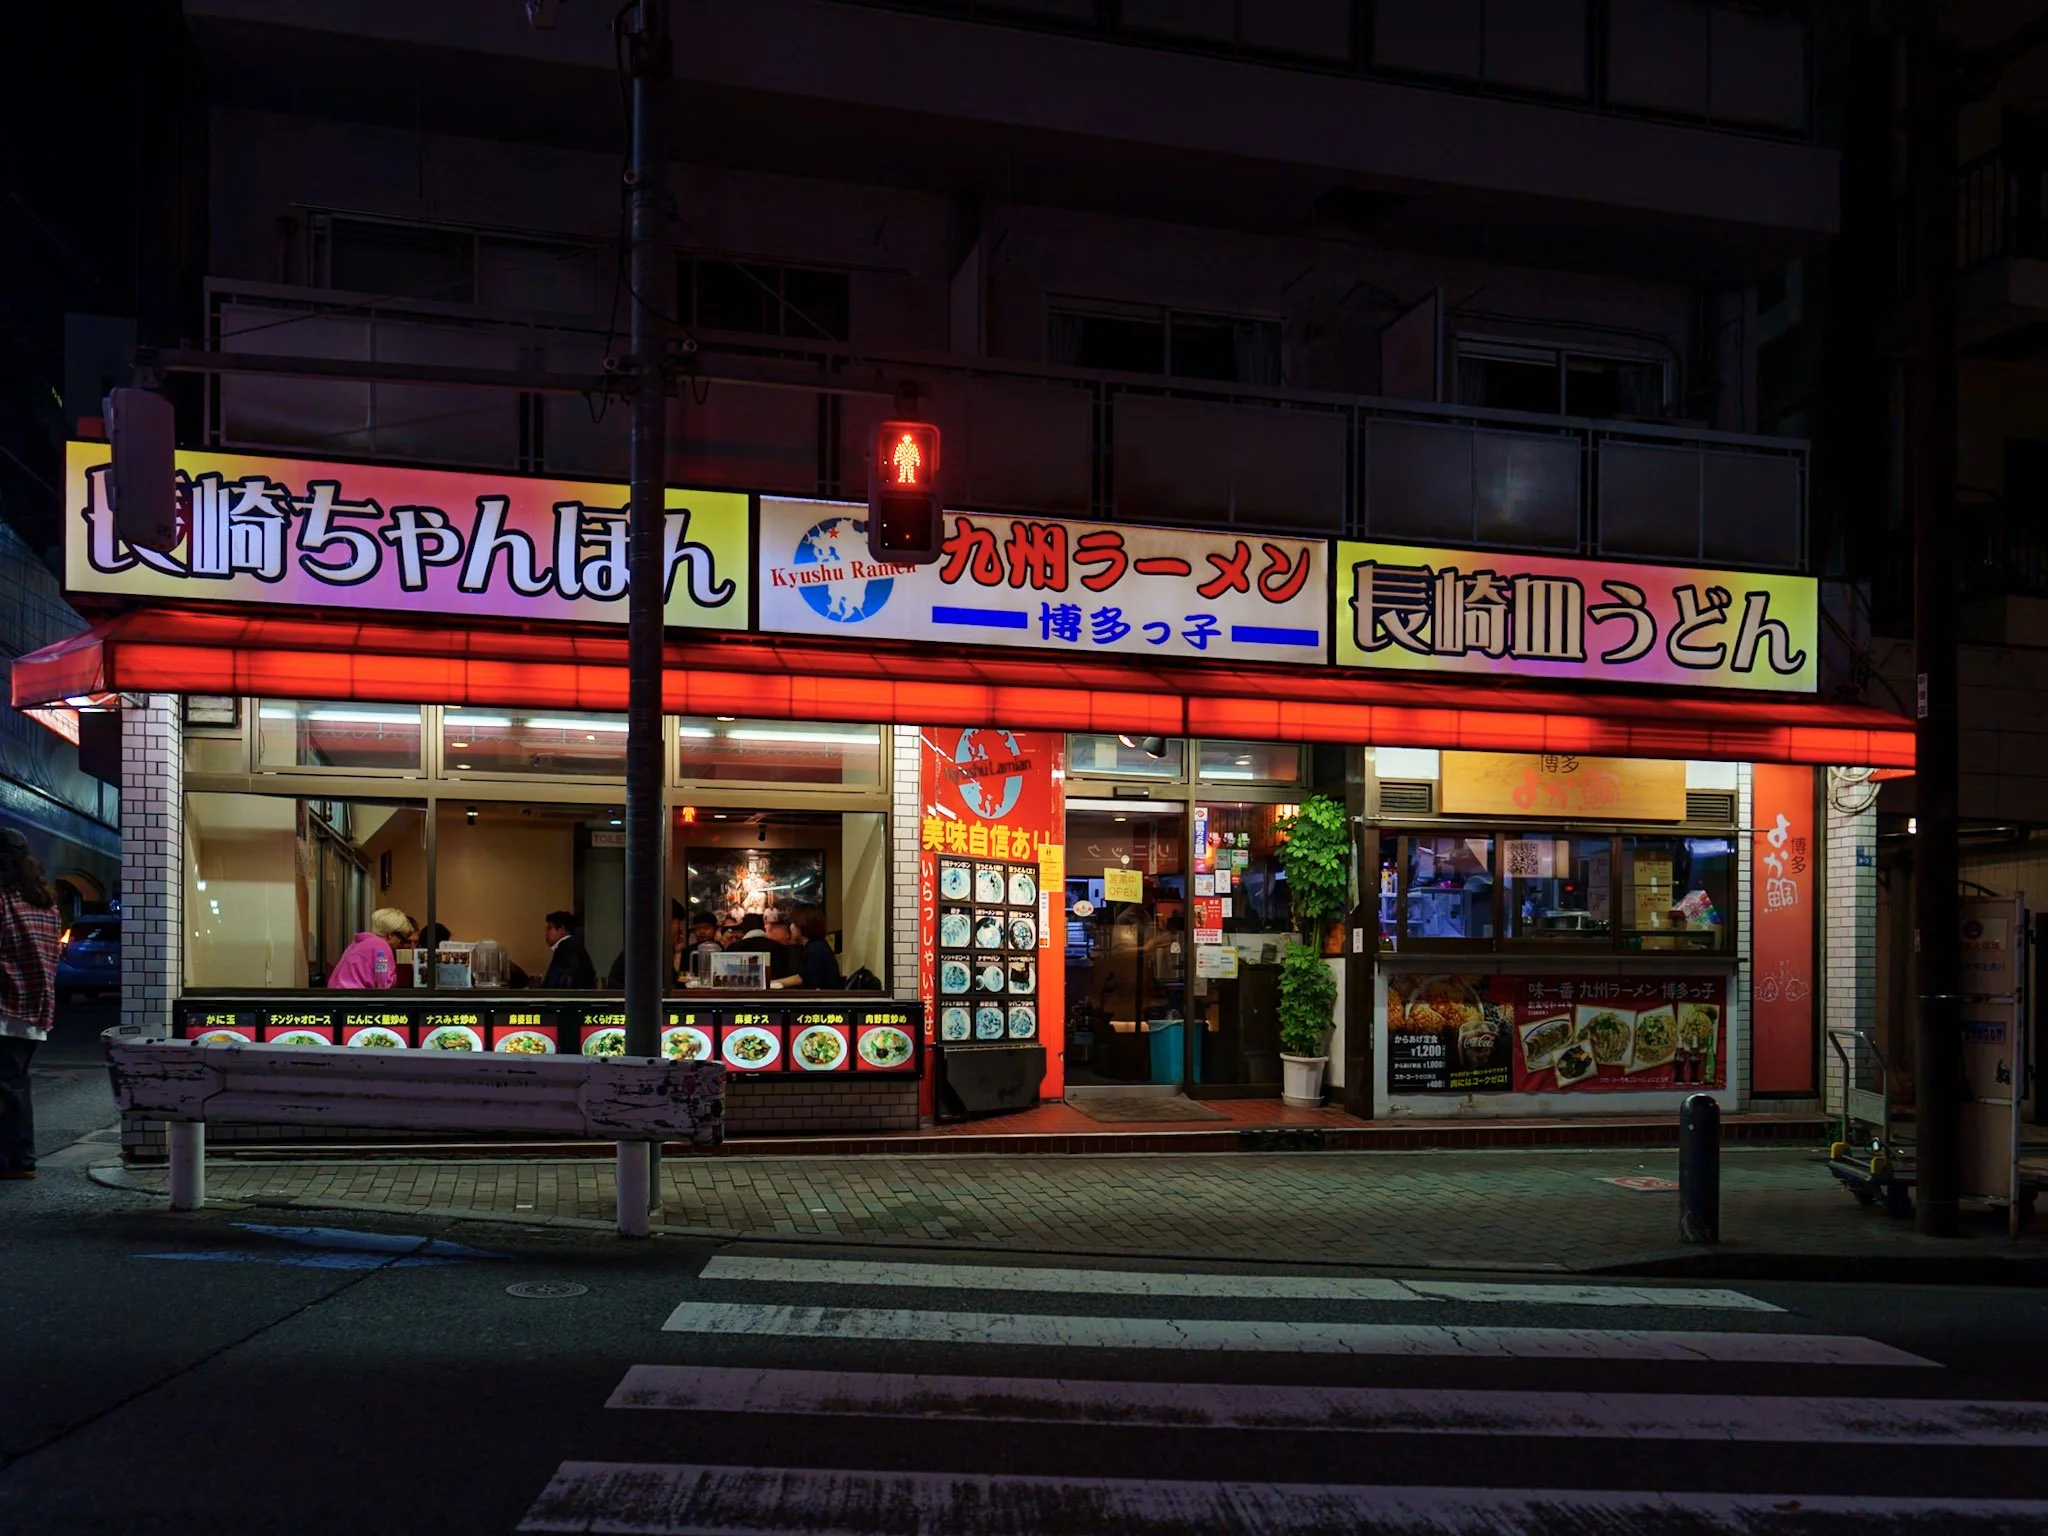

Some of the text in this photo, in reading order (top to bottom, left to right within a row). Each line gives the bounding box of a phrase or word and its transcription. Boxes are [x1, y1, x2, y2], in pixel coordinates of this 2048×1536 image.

[938, 517, 1311, 604] 九州ラーメン
[770, 564, 844, 588] Kyushu
[1351, 560, 1806, 674] 長崎皿うどん
[1038, 601, 1223, 650] 博多っ子
[1540, 754, 1580, 774] 博多
[594, 834, 626, 844] TOILE
[1791, 836, 1807, 874] 博多
[1109, 874, 1137, 884] 営業中
[1109, 887, 1137, 897] OPEN
[921, 859, 934, 1036] いらっしゃいませ
[1528, 981, 1716, 999] 味一番 九州ラーメン 博多っ子
[206, 1013, 236, 1025] かに玉
[270, 1013, 331, 1025] チンジャオロース
[734, 1013, 770, 1025] 麻婆ナス
[1394, 1035, 1438, 1044] からあげ定食
[1411, 1045, 1442, 1058] ¥1,200
